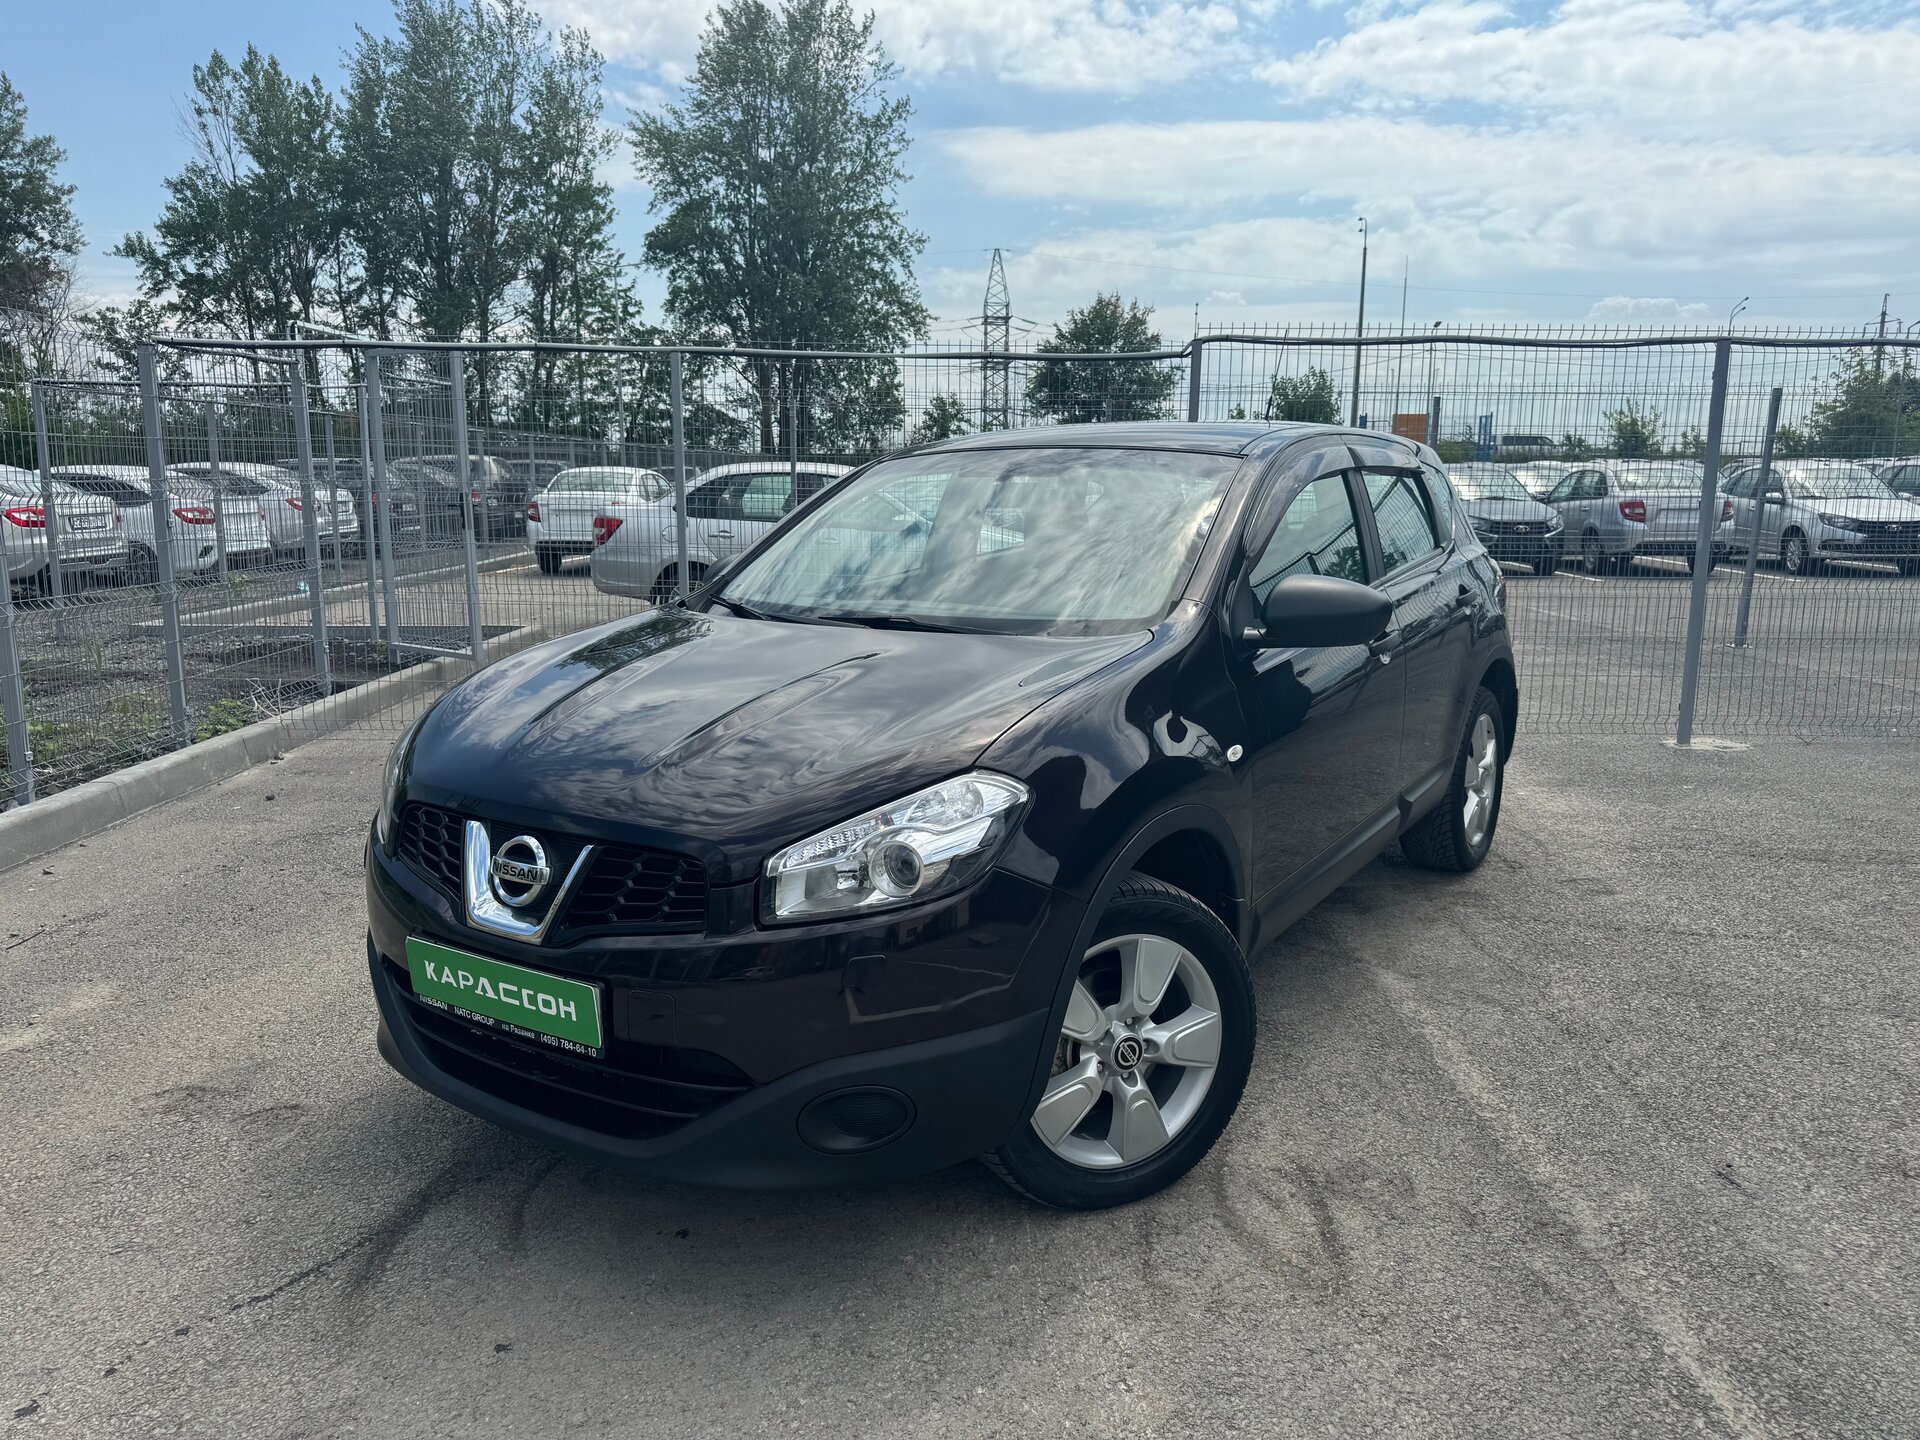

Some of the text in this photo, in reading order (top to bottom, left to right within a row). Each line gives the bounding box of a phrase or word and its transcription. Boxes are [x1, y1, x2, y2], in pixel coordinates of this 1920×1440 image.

[494, 861, 539, 882] NISSAN
[424, 959, 578, 1022] КАРАССОН
[419, 994, 448, 1011] NISSAN
[471, 1012, 495, 1027] GROUP
[540, 1033, 559, 1047] (495)
